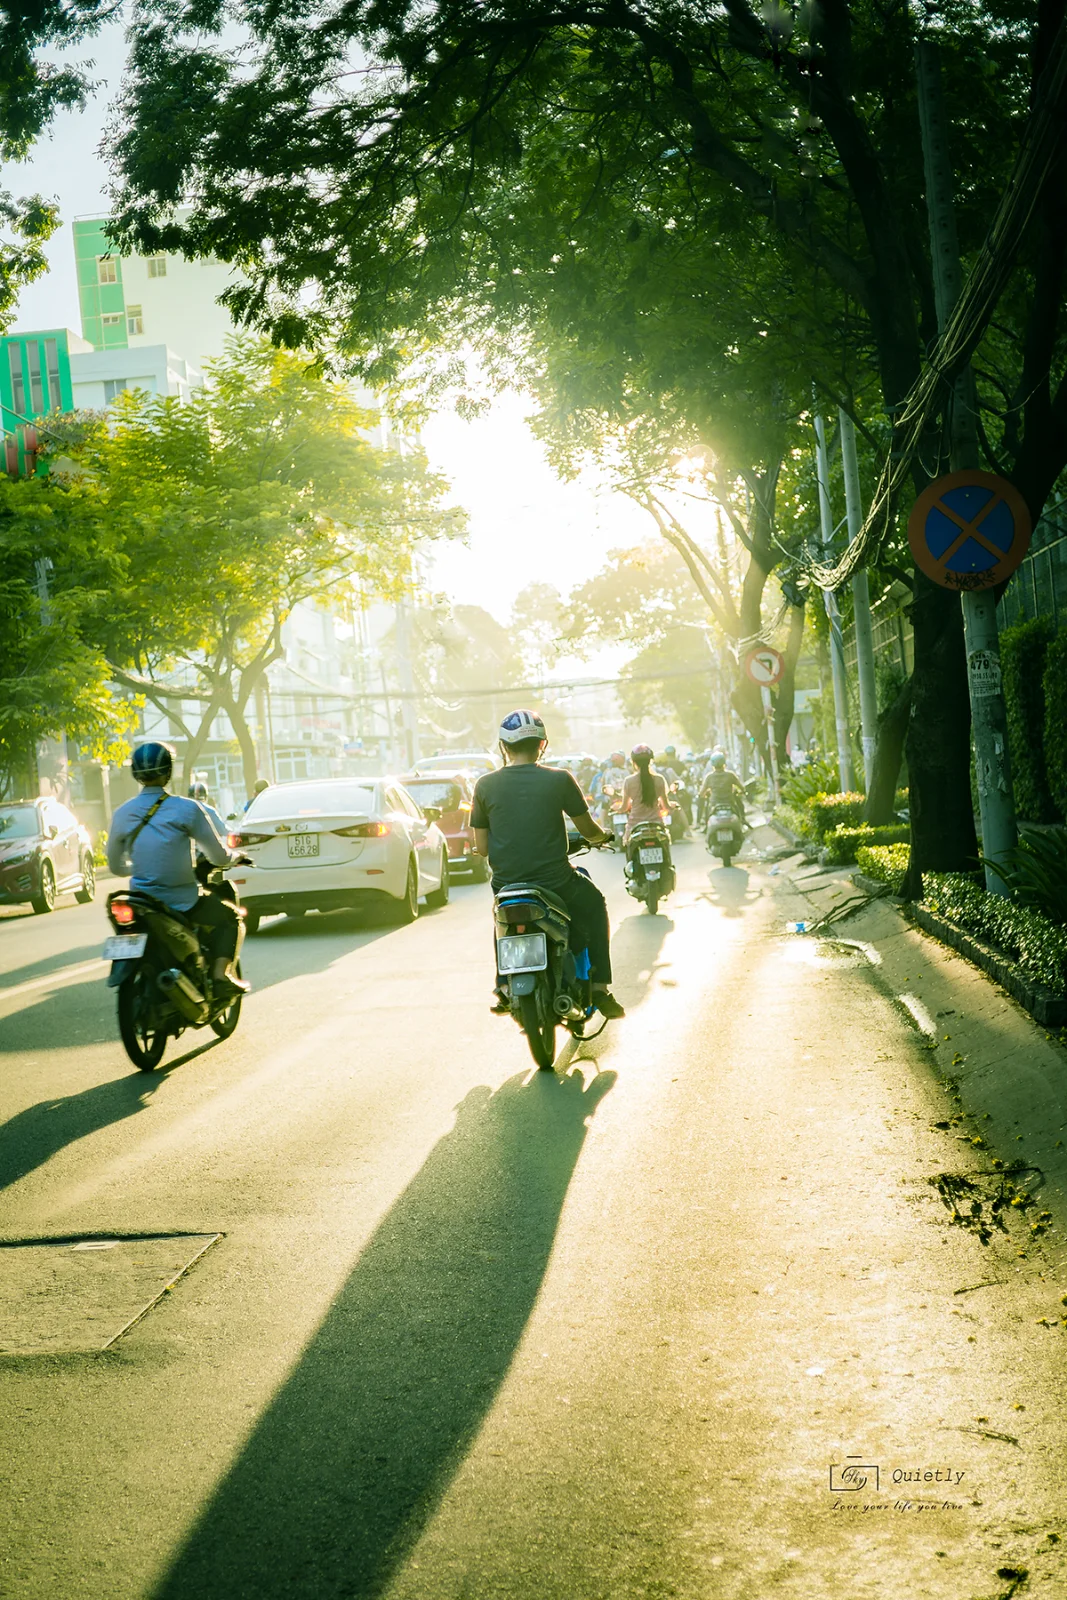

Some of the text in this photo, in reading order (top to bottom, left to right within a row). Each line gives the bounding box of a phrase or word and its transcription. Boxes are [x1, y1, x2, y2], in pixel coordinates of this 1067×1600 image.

[971, 659, 990, 670] 479
[294, 836, 311, 845] 51G
[289, 846, 318, 856] 456.28
